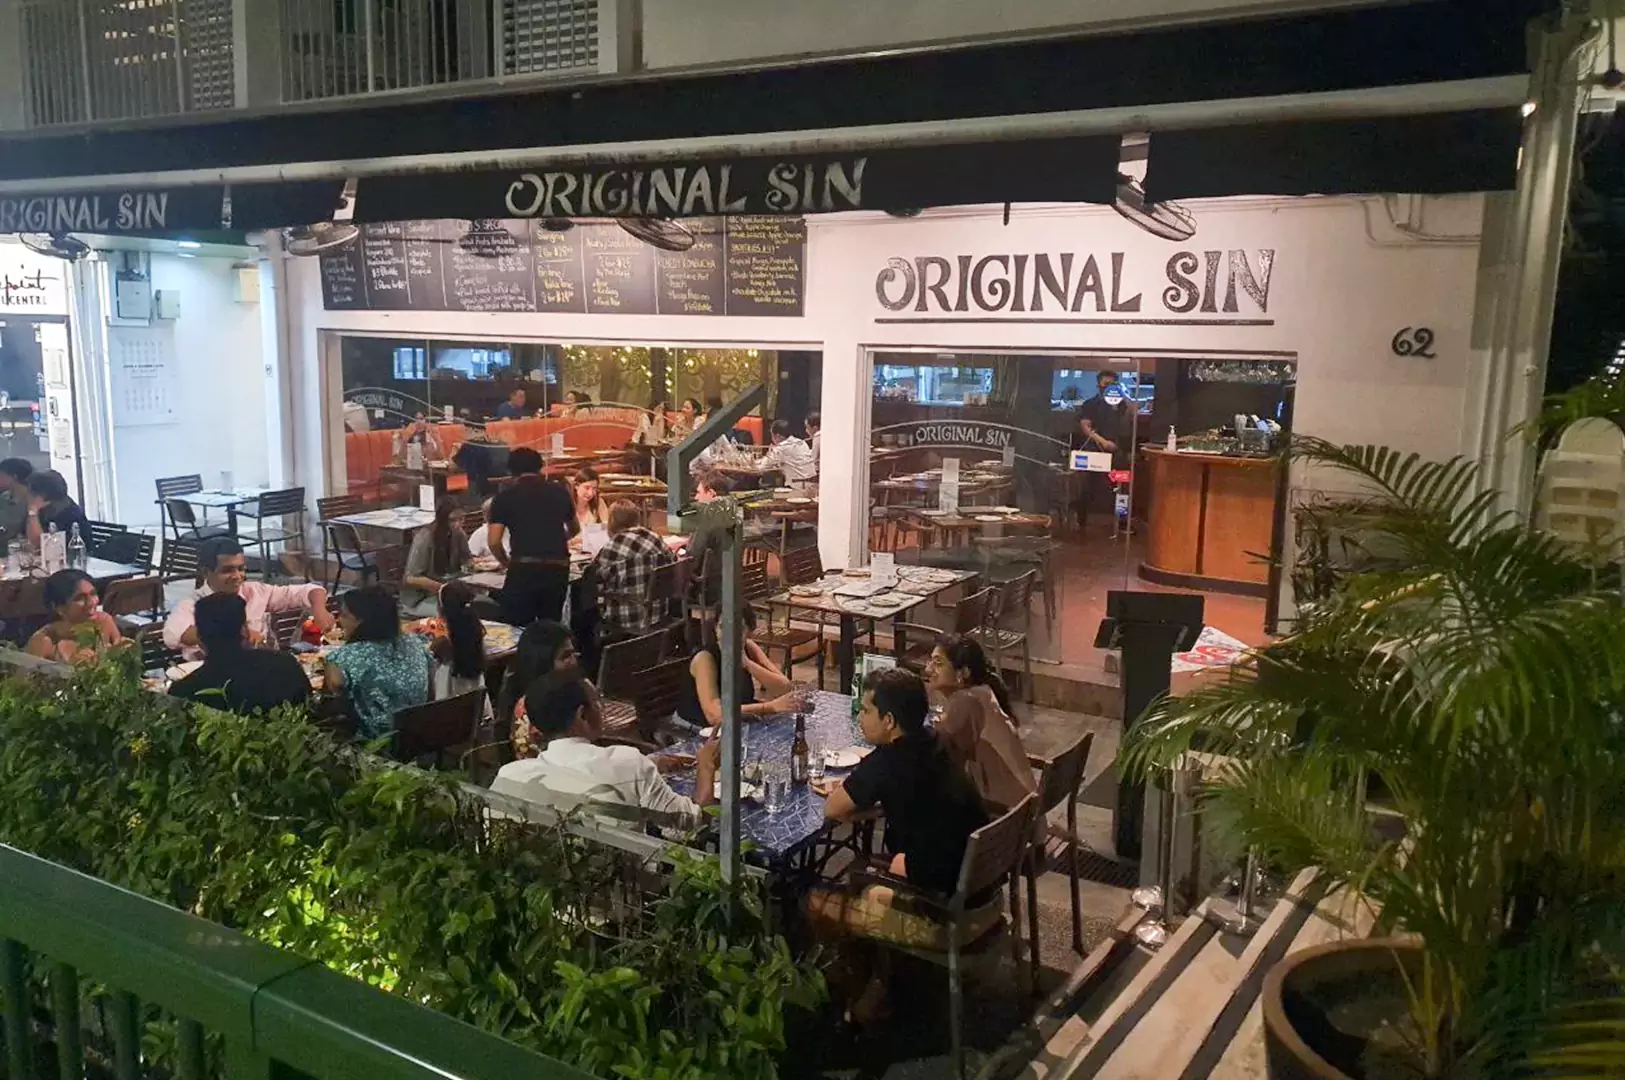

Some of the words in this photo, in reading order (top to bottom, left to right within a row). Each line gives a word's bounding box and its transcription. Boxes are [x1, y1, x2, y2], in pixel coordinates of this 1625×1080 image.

[504, 164, 748, 217] ORIGINAL
[764, 157, 867, 212] SIN
[115, 191, 168, 230] SIN
[875, 251, 1143, 313] ORIGINAL
[1161, 248, 1275, 314] SIN
[1391, 326, 1437, 359] 62
[915, 425, 983, 443] ORIGINAL
[985, 428, 1011, 446] SIN
